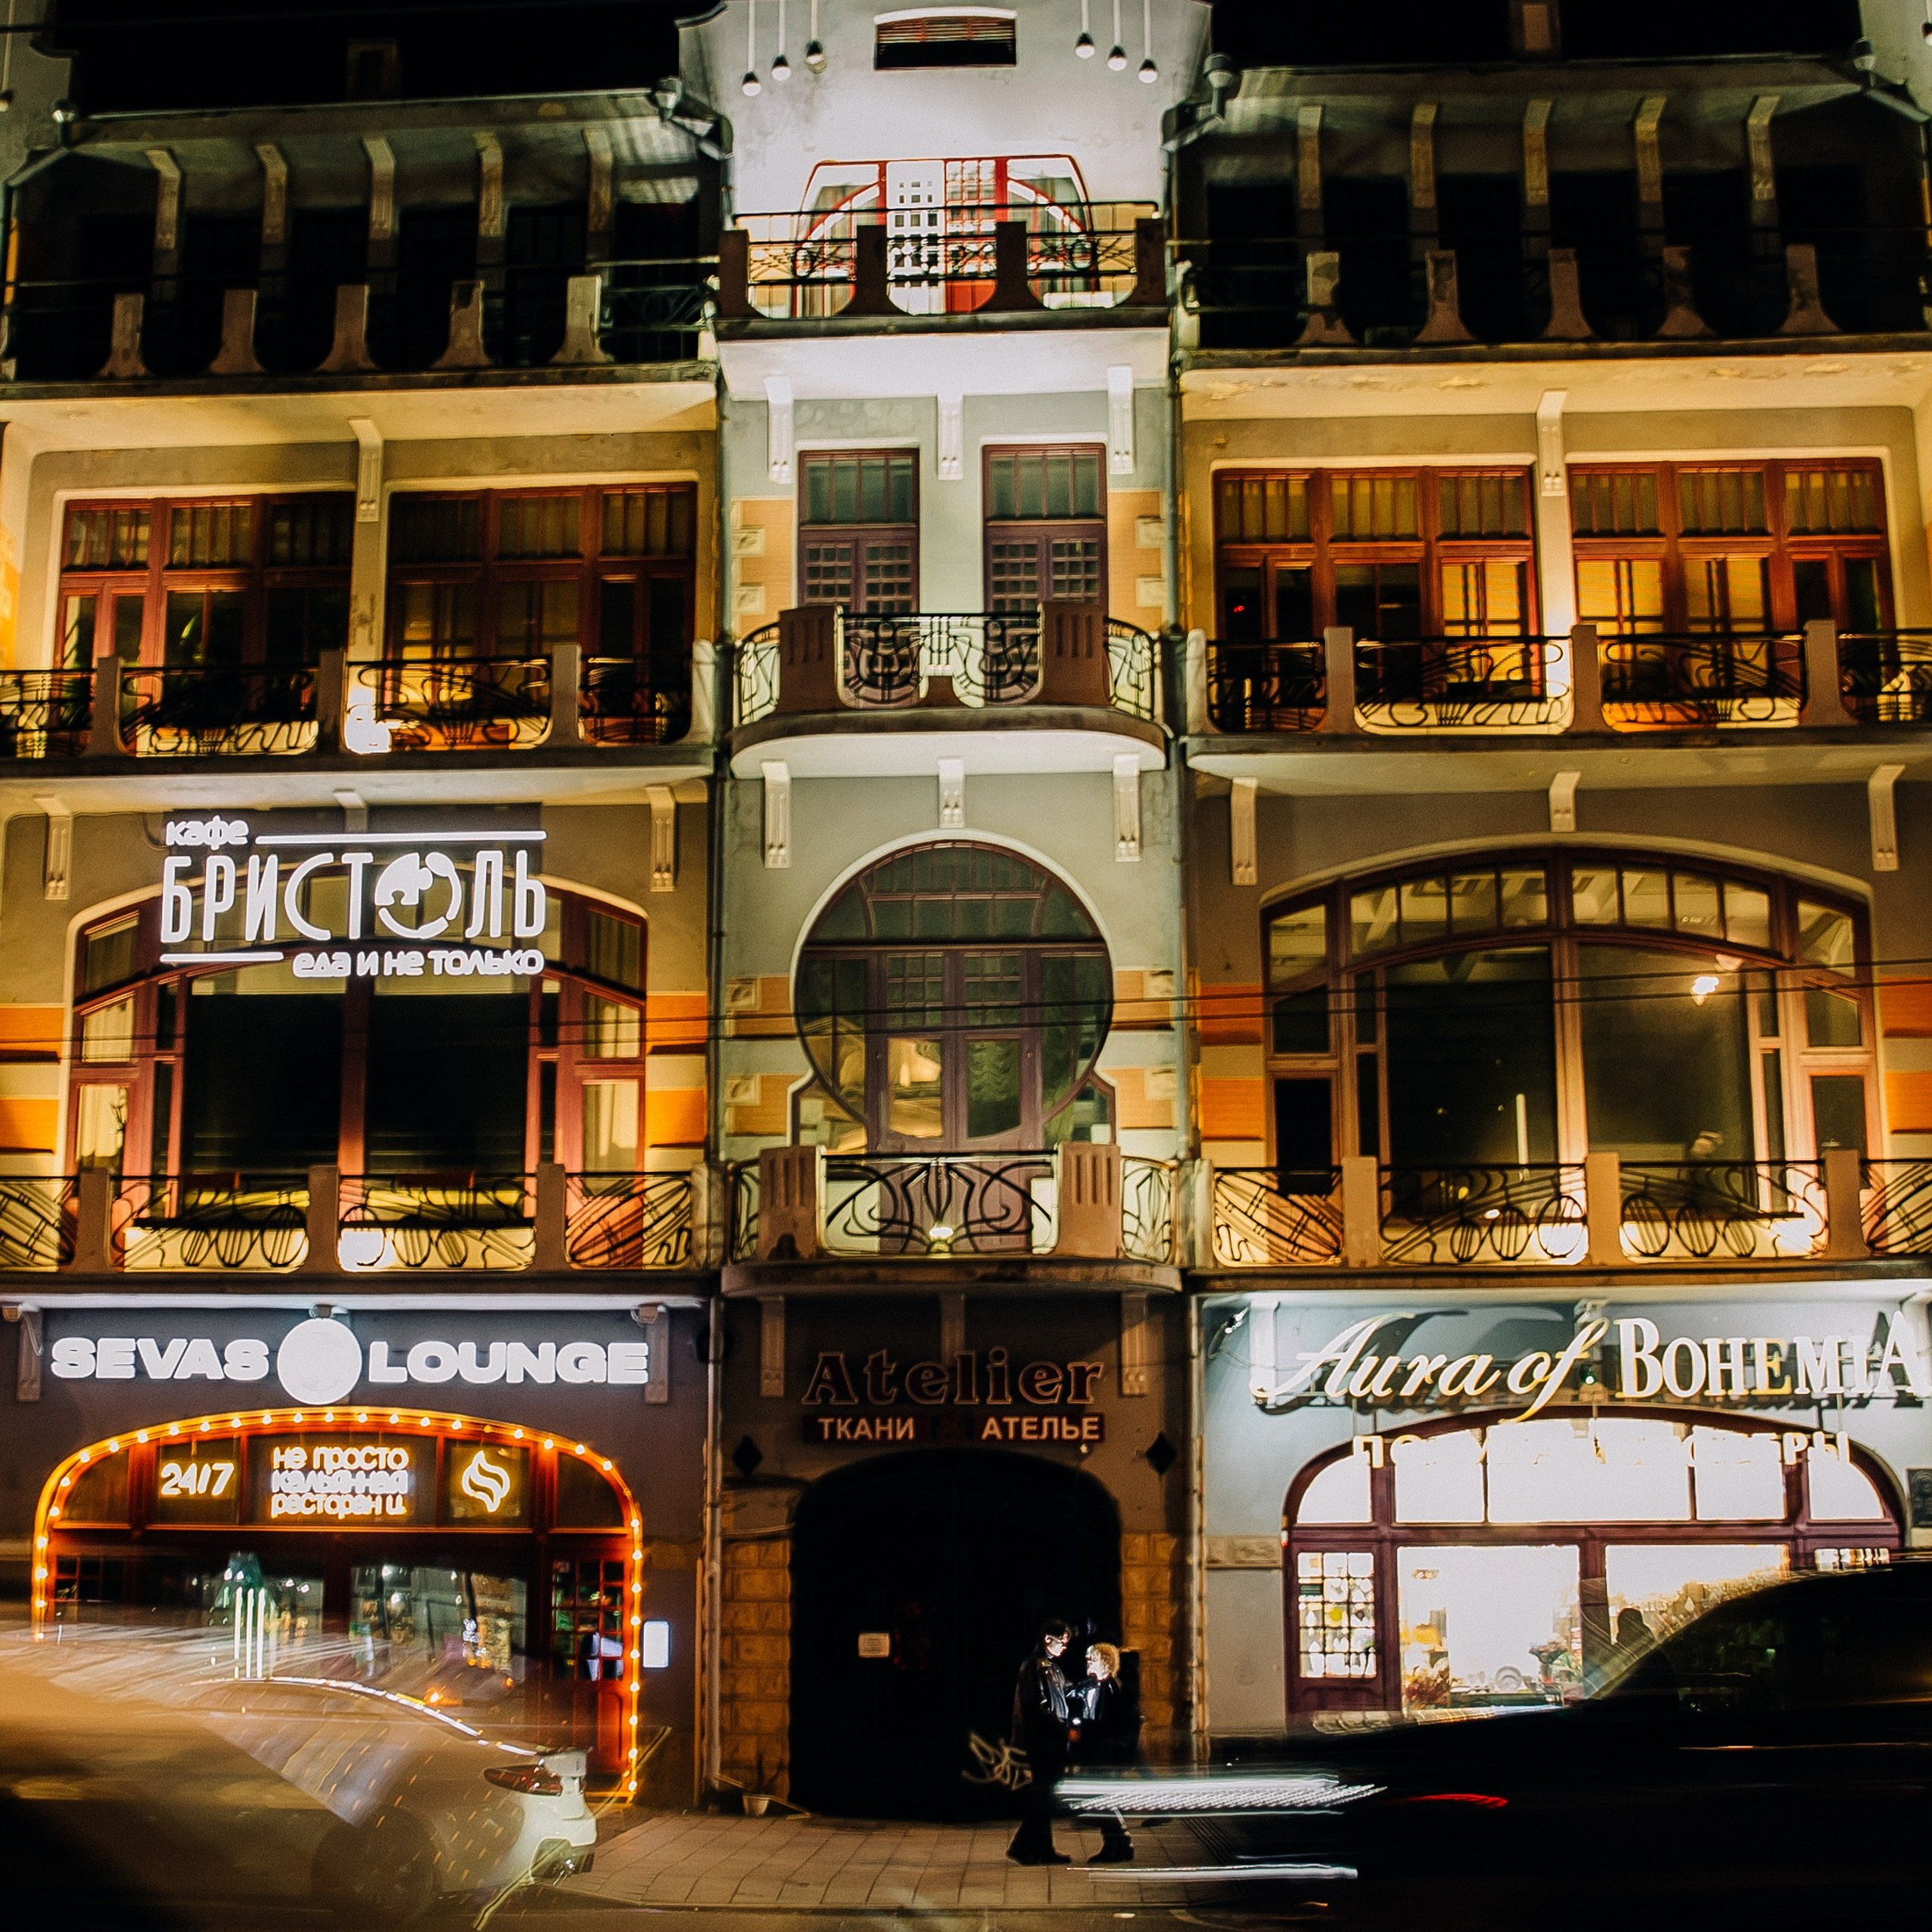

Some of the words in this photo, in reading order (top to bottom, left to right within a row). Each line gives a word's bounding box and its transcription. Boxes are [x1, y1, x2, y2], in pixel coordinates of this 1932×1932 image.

[165, 814, 249, 851] кафе
[160, 849, 546, 943] БРИСТОЛЬ
[293, 951, 352, 978] еда
[356, 950, 379, 977] и
[383, 949, 425, 977] не
[427, 949, 545, 976] только
[51, 1337, 269, 1380] SEVAS
[368, 1340, 649, 1385] LOUNGE
[801, 1346, 1106, 1405] Atelier
[1248, 1312, 1503, 1398] Aura
[1497, 1316, 1611, 1425] of
[1613, 1310, 1932, 1398] BOHEMIA
[817, 1417, 915, 1441] ТКАНИ
[981, 1416, 1101, 1441] АТЕЛЬЕ
[272, 1445, 308, 1469] не
[312, 1445, 409, 1475] просто
[160, 1462, 235, 1496] 24/7
[272, 1469, 409, 1494] кальянная
[270, 1493, 383, 1520] ресторан
